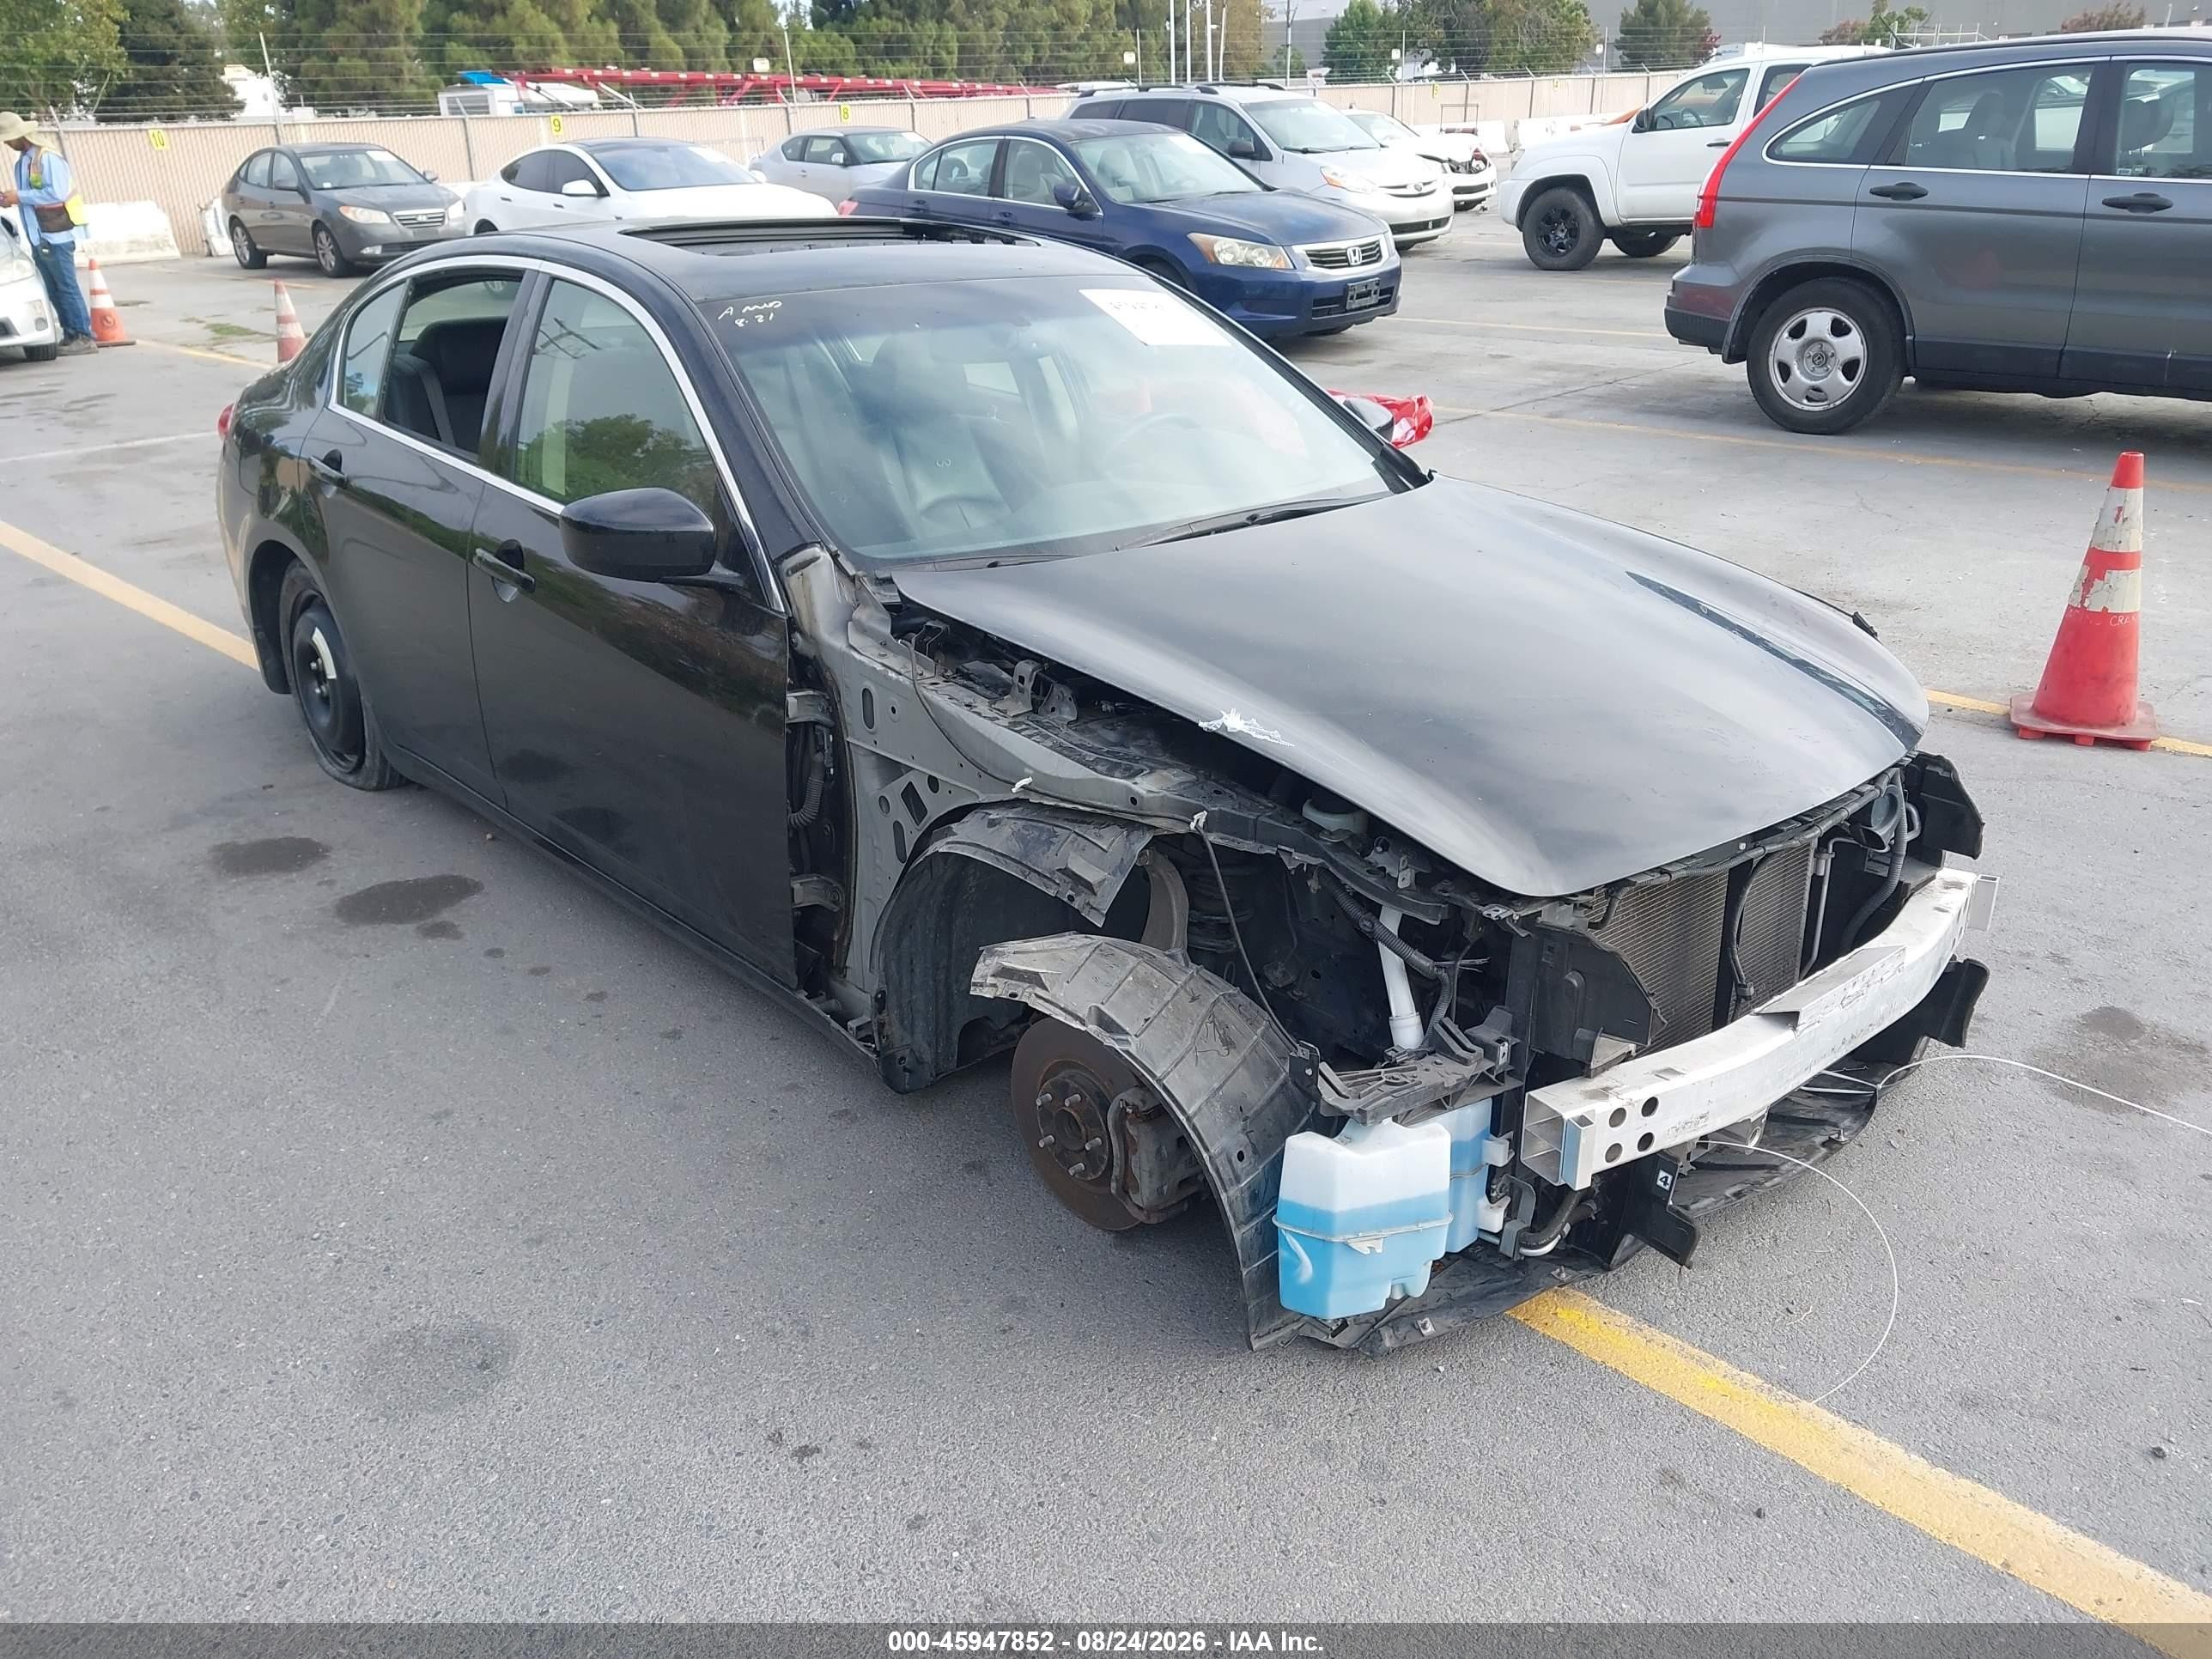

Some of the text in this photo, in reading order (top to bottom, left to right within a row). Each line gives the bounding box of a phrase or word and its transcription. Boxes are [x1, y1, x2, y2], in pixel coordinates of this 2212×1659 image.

[842, 106, 849, 120] 8
[552, 118, 561, 132] 9
[152, 130, 165, 147] 10
[1659, 1175, 1670, 1187] 4
